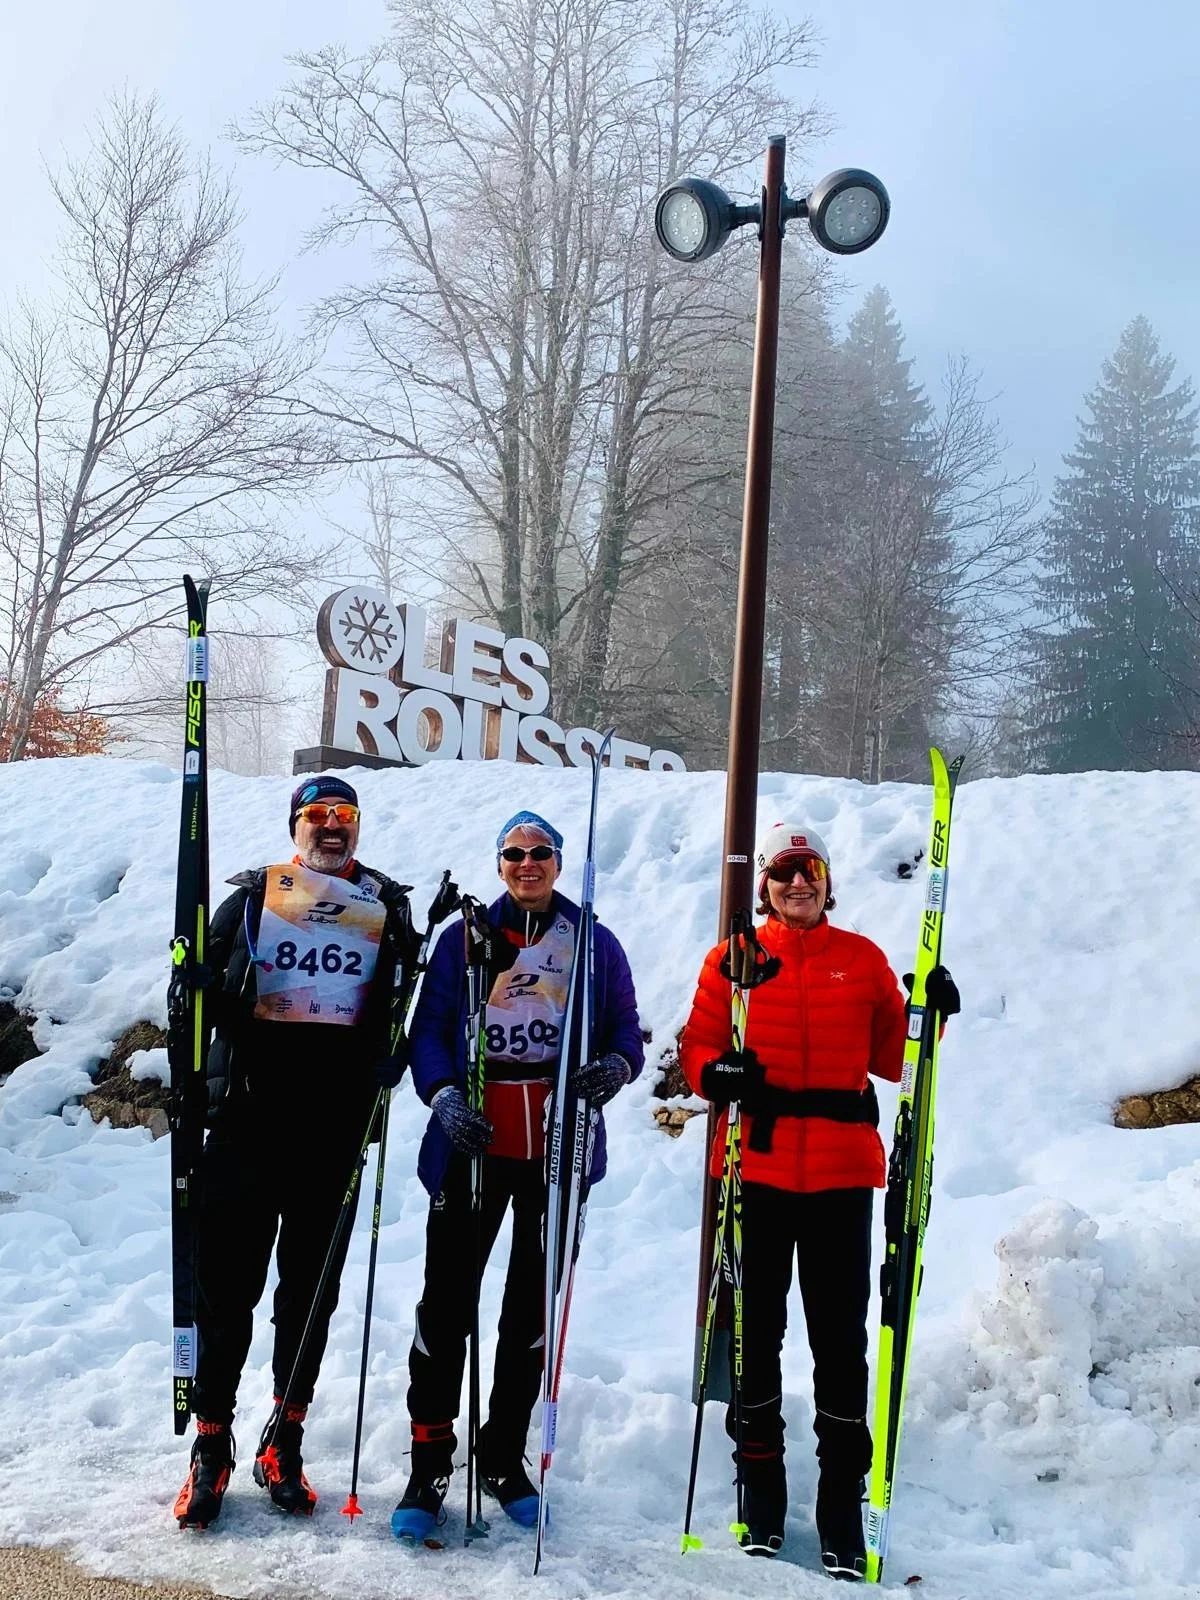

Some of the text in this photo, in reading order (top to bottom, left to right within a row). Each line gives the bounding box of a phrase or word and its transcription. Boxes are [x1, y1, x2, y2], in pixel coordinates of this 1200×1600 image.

[402, 602, 551, 714] LES
[931, 880, 943, 905] LUMI
[274, 940, 363, 977] 8462
[485, 1018, 560, 1056] 8502
[724, 1064, 744, 1074] Sport
[549, 1121, 562, 1186] MADSHUS
[573, 1109, 585, 1175] MADSHUS
[903, 1179, 912, 1234] FISCHER
[179, 1342, 191, 1370] LUMI
[734, 1289, 743, 1377] PREMIO
